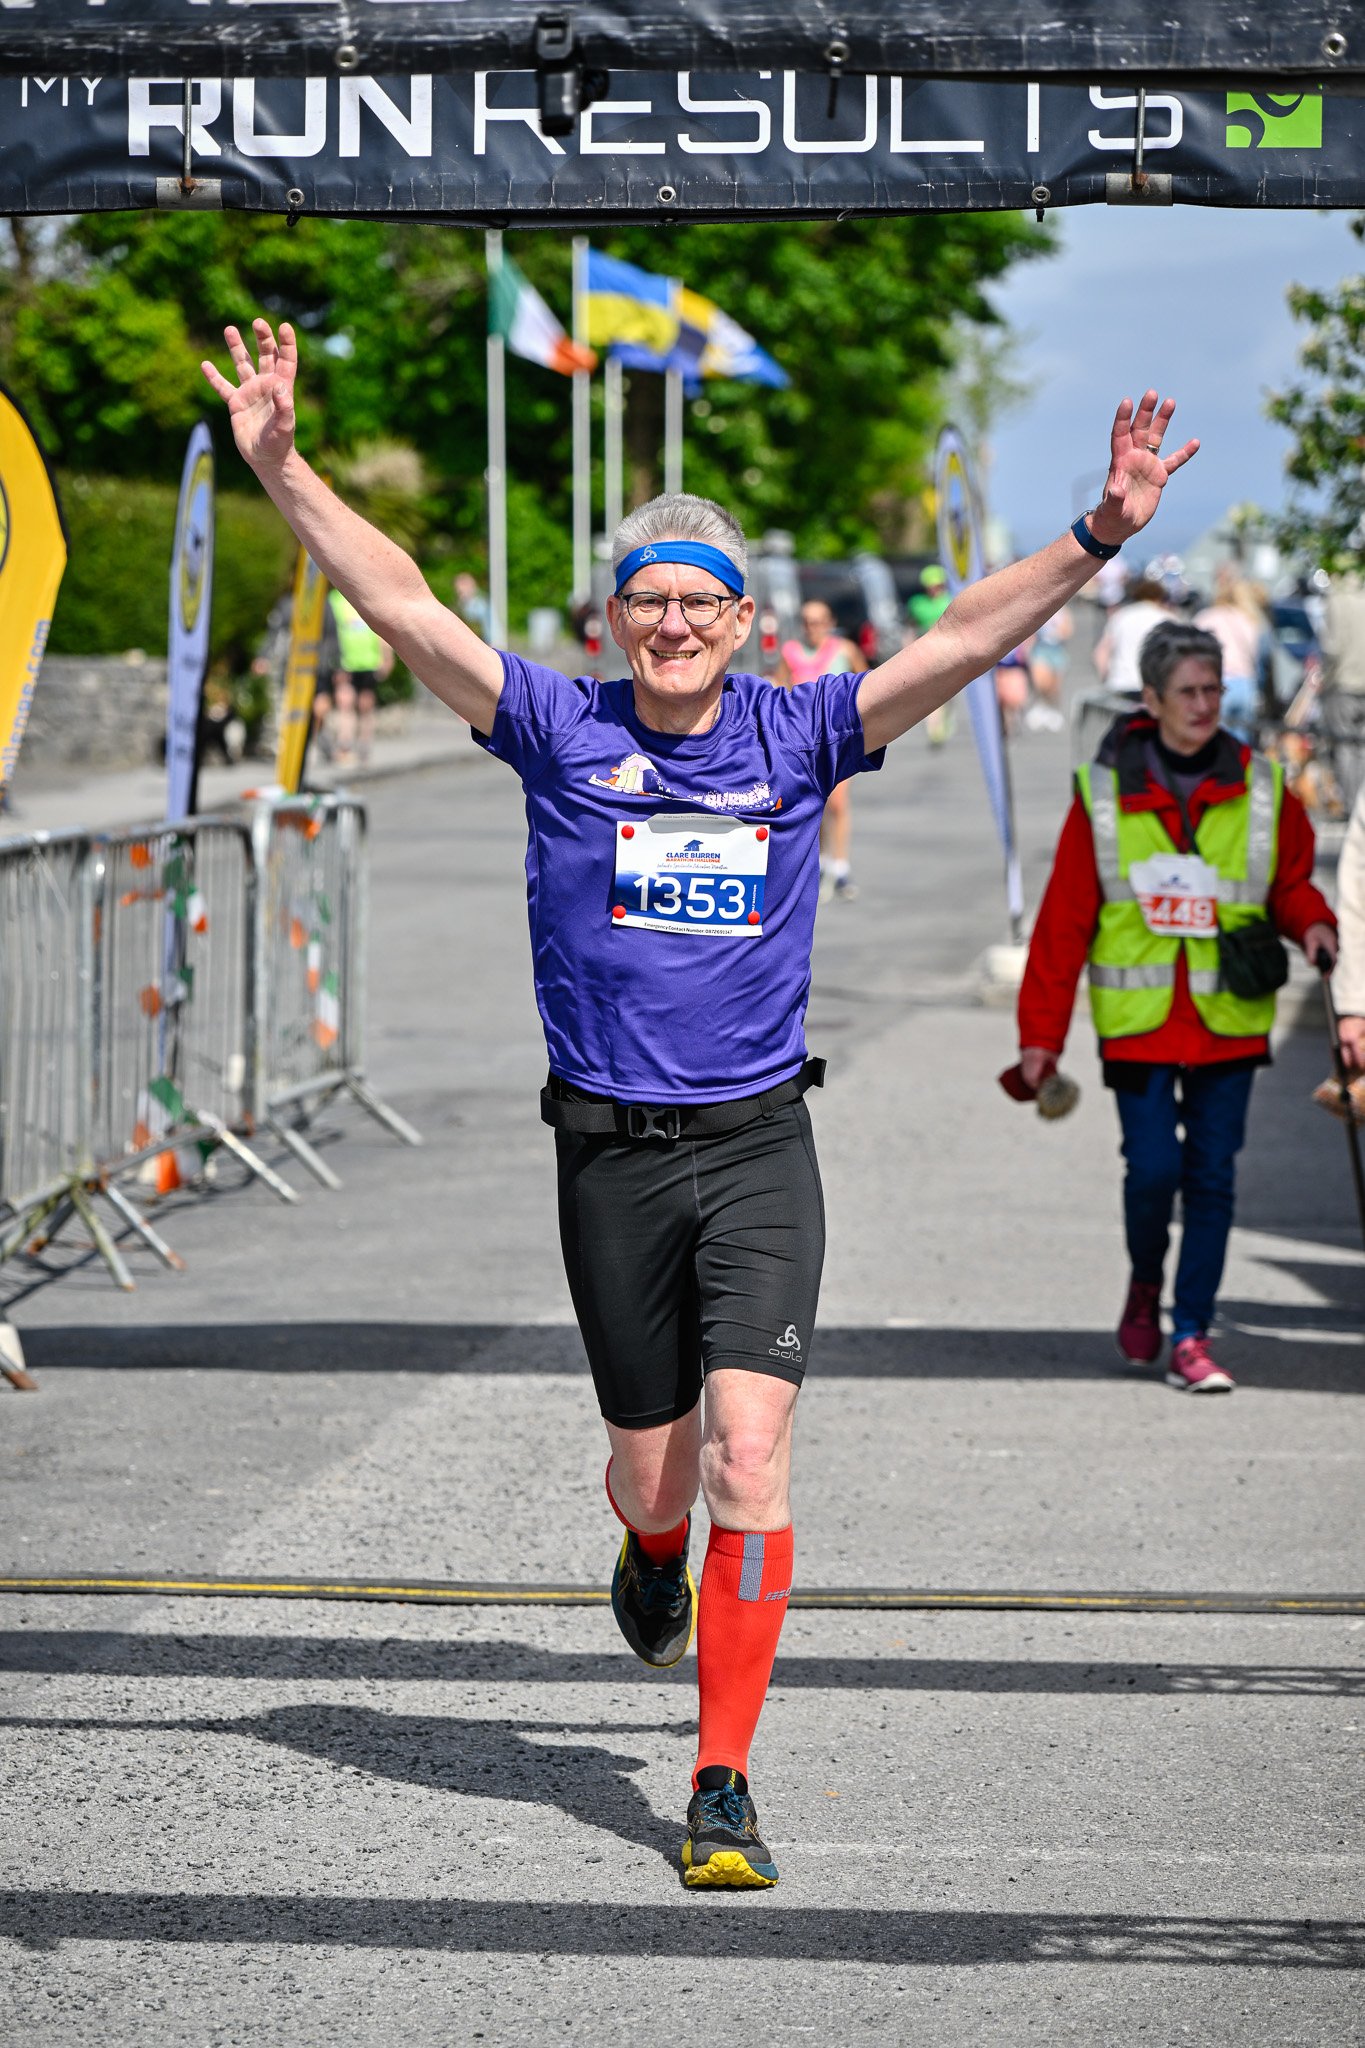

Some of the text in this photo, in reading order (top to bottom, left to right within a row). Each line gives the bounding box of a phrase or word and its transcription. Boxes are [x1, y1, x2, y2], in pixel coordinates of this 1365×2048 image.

[21, 77, 102, 108] MY
[127, 76, 433, 157] RUN
[633, 875, 746, 919] 1353
